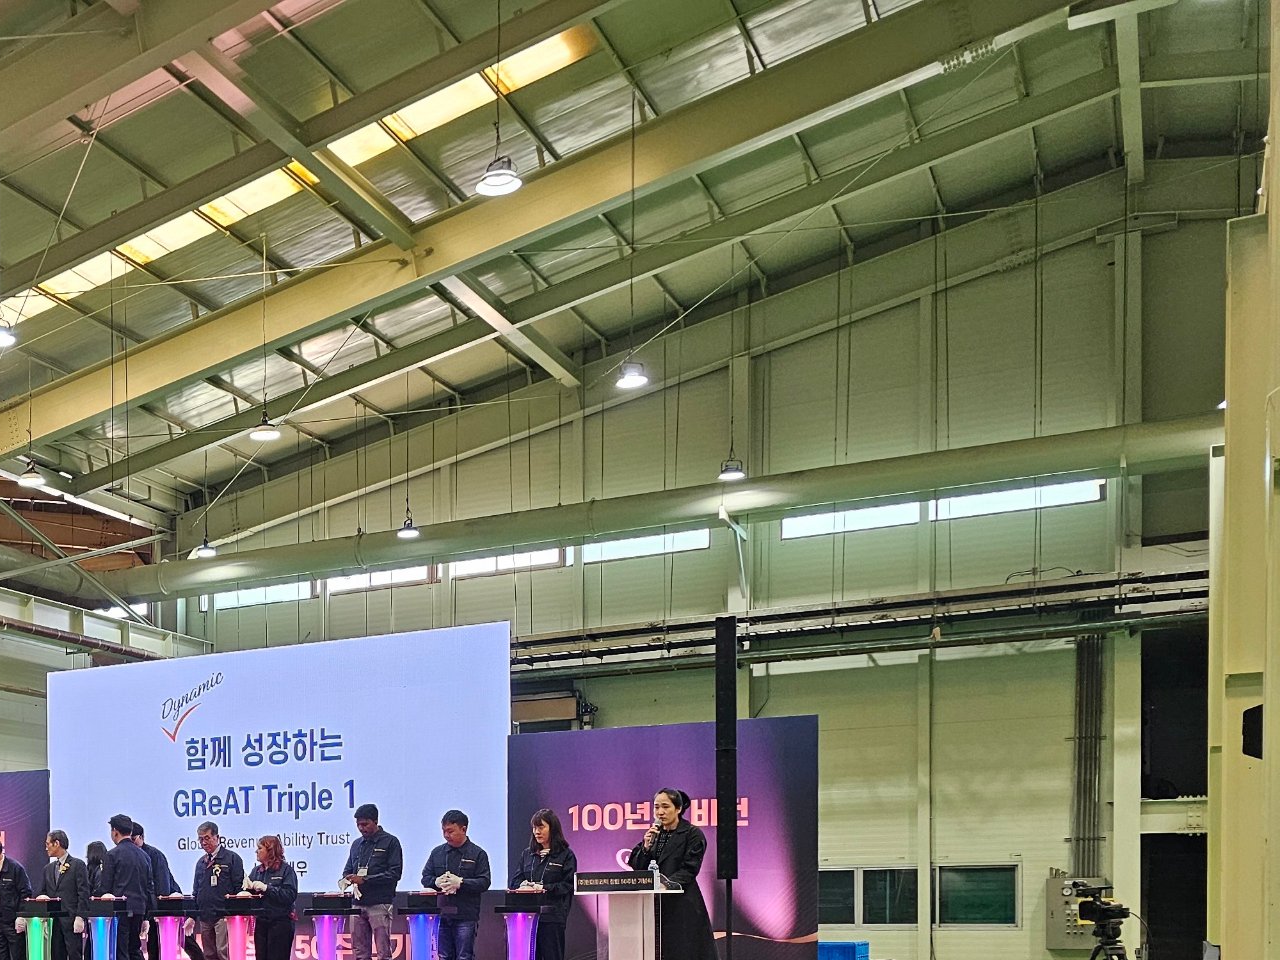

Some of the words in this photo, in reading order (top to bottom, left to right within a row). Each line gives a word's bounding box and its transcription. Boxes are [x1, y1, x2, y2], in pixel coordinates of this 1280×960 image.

[161, 672, 224, 721] Dynamic
[185, 737, 232, 770] 함께
[241, 728, 343, 766] 성장하는
[173, 786, 255, 817] GReAT
[262, 782, 333, 819] Triple
[343, 779, 355, 808] 1
[569, 801, 651, 831] 100년
[317, 832, 350, 845] Trust
